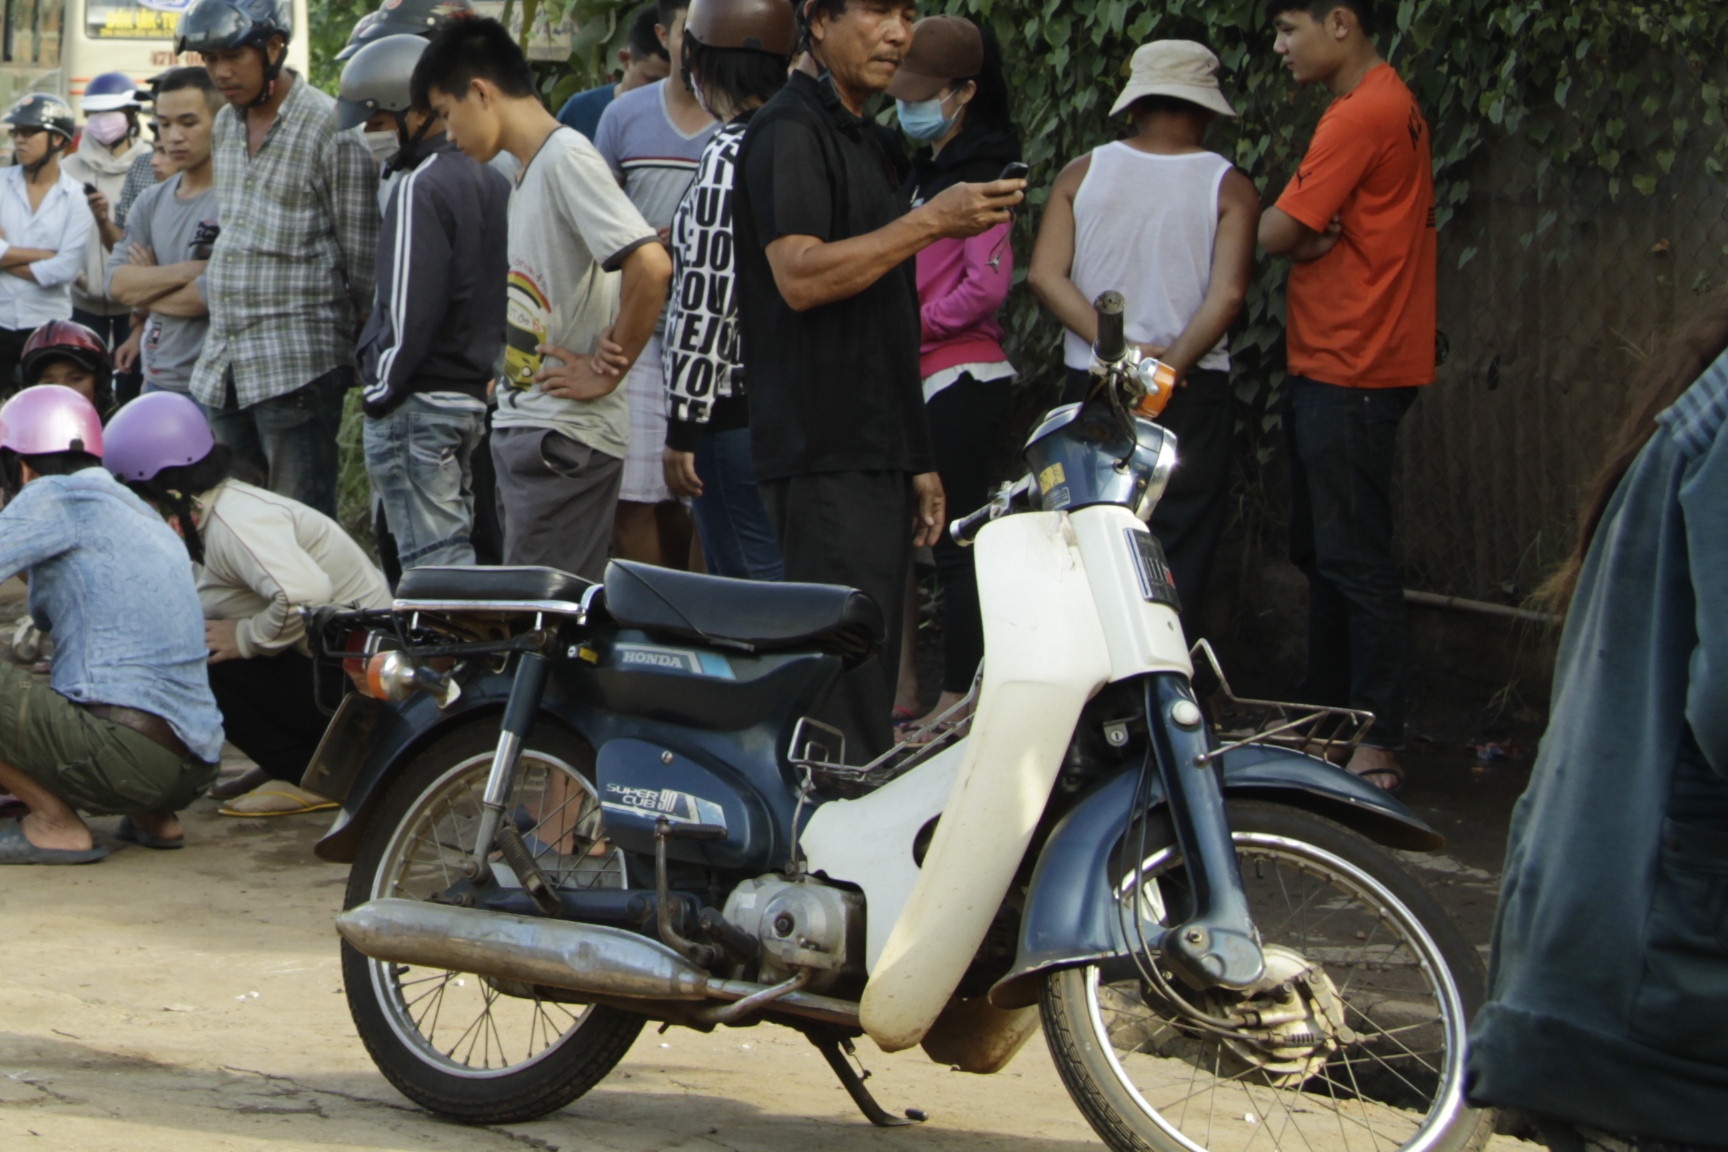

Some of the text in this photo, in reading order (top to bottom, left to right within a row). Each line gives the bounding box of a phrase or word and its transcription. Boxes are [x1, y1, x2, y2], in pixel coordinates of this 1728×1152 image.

[623, 651, 683, 668] HONDA
[606, 783, 659, 799] SUPER
[622, 794, 655, 809] CUB
[657, 788, 678, 812] 90
